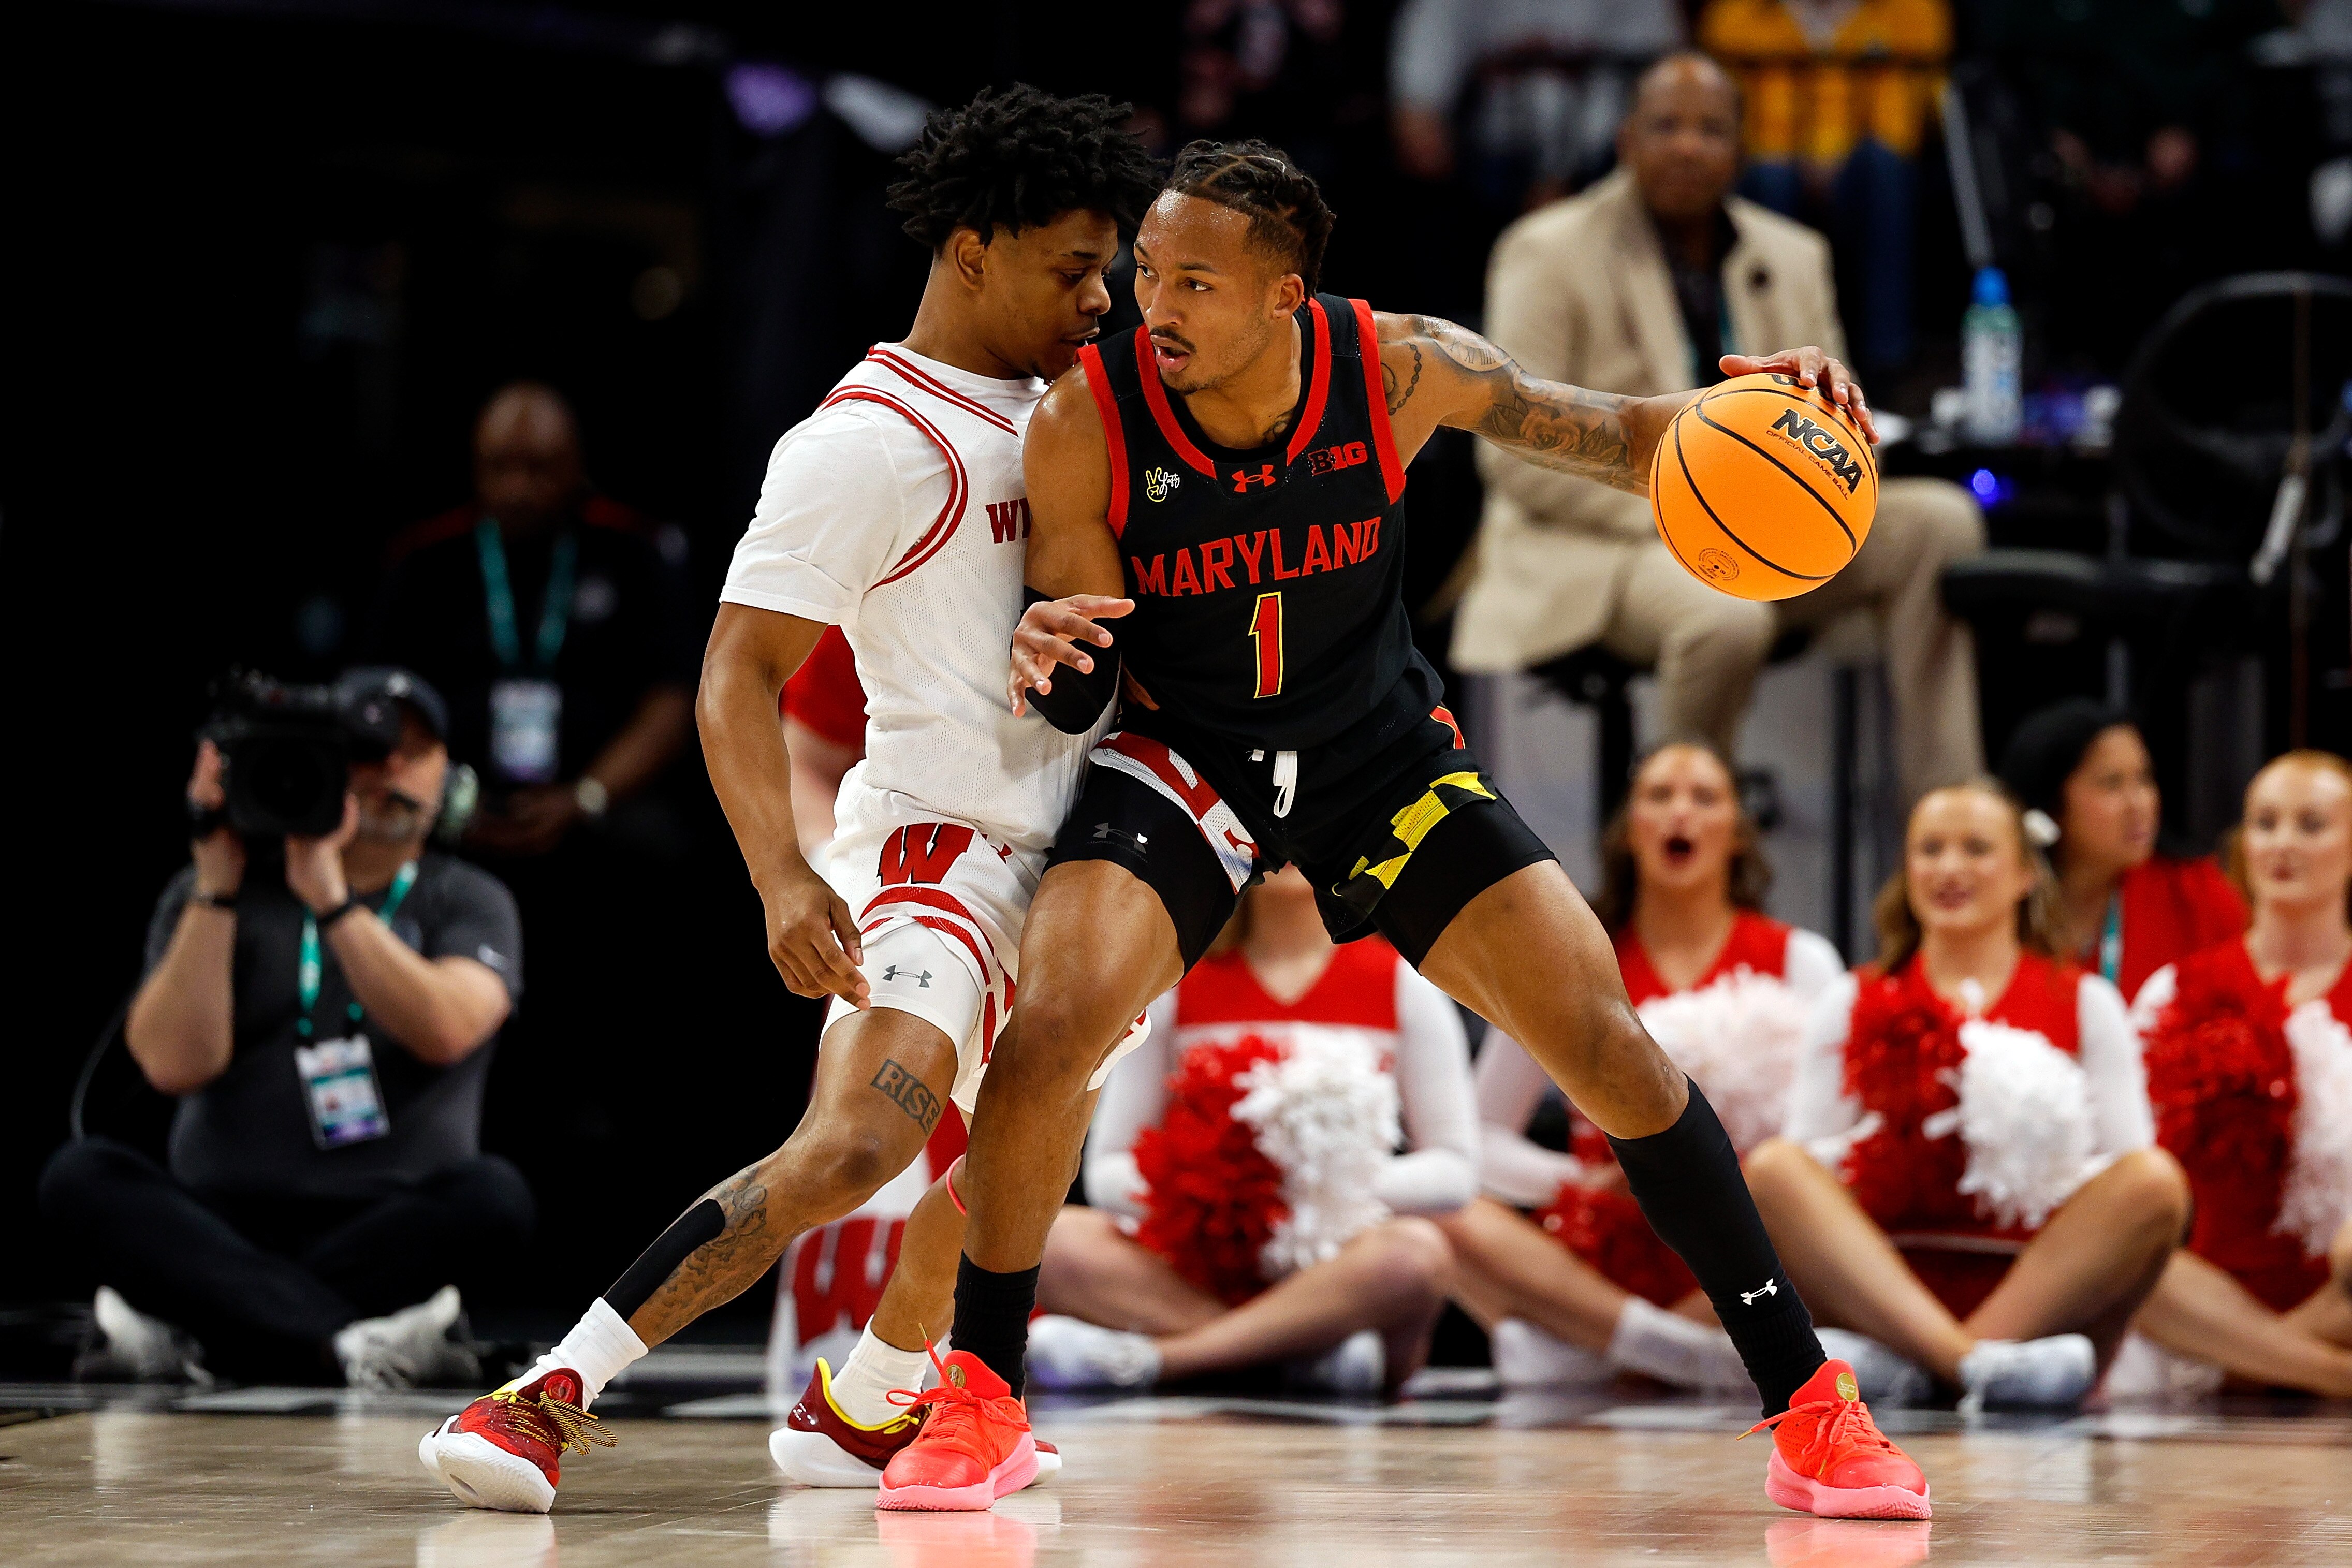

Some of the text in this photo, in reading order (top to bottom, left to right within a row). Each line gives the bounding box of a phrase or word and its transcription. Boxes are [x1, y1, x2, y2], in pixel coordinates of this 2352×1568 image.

[1765, 430, 1849, 501] OFFICIAL GAME BALL
[1770, 407, 1863, 494] NCAA
[1131, 516, 1381, 597] MARYLAND
[1248, 591, 1282, 699] 1
[876, 822, 976, 887] W
[870, 1059, 941, 1136] RISE
